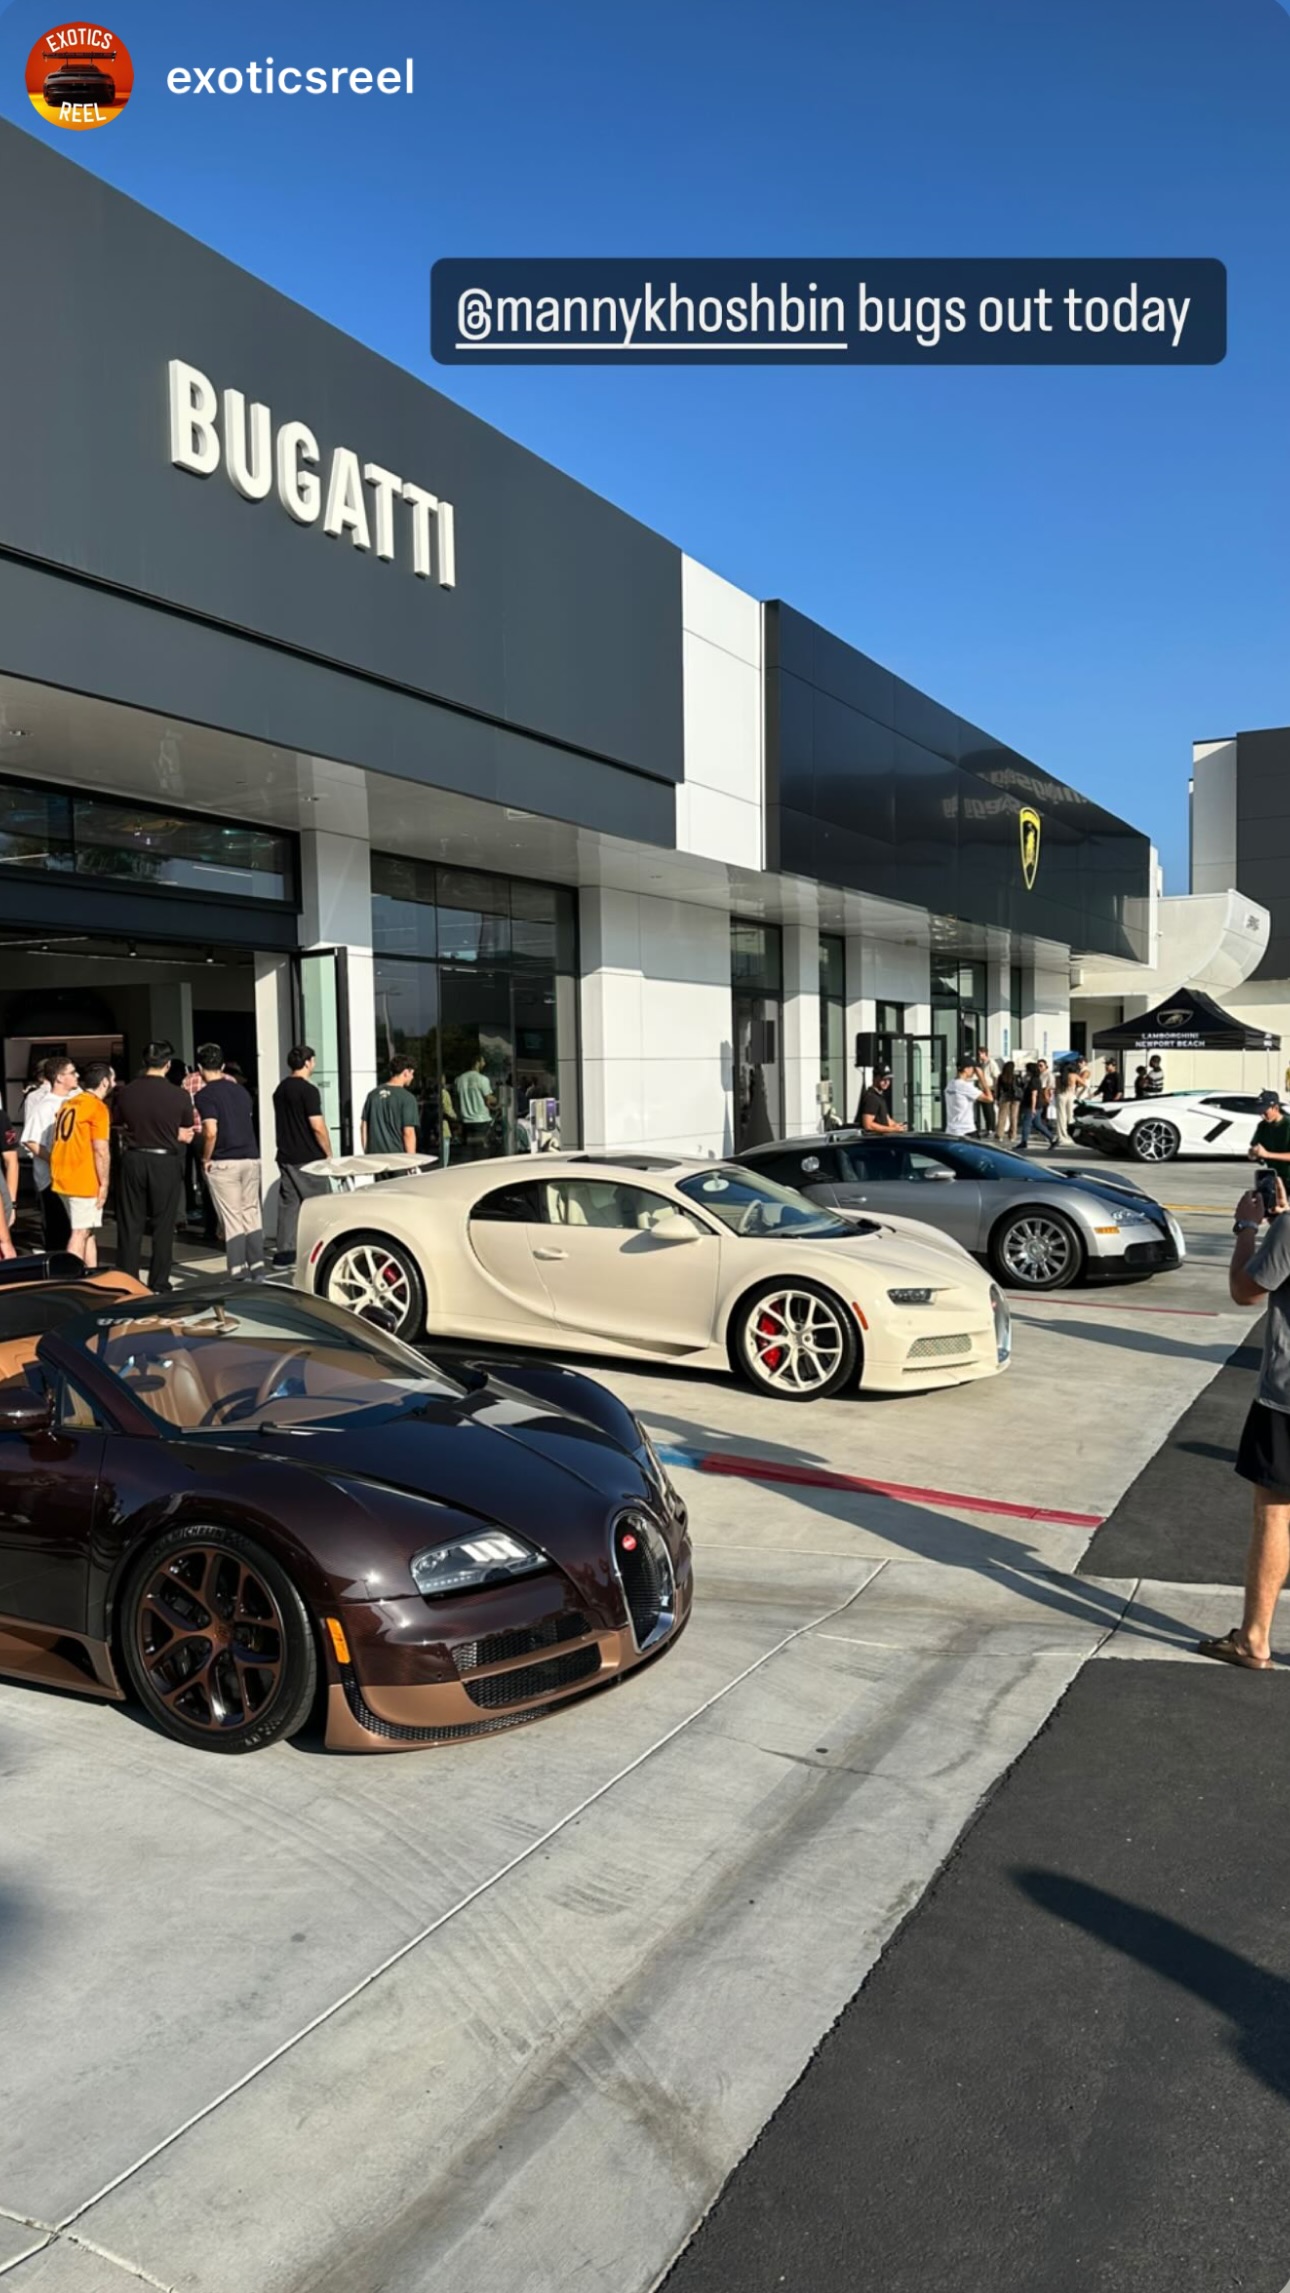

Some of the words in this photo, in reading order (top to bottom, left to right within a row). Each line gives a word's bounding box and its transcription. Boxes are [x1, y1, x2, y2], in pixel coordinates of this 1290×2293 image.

[168, 358, 456, 589] BUGATTI
[1135, 1040, 1175, 1048] NEWPORT
[1176, 1040, 1206, 1048] BEACH
[1141, 1032, 1200, 1040] LAMBORGHINI
[55, 1107, 76, 1142] 10
